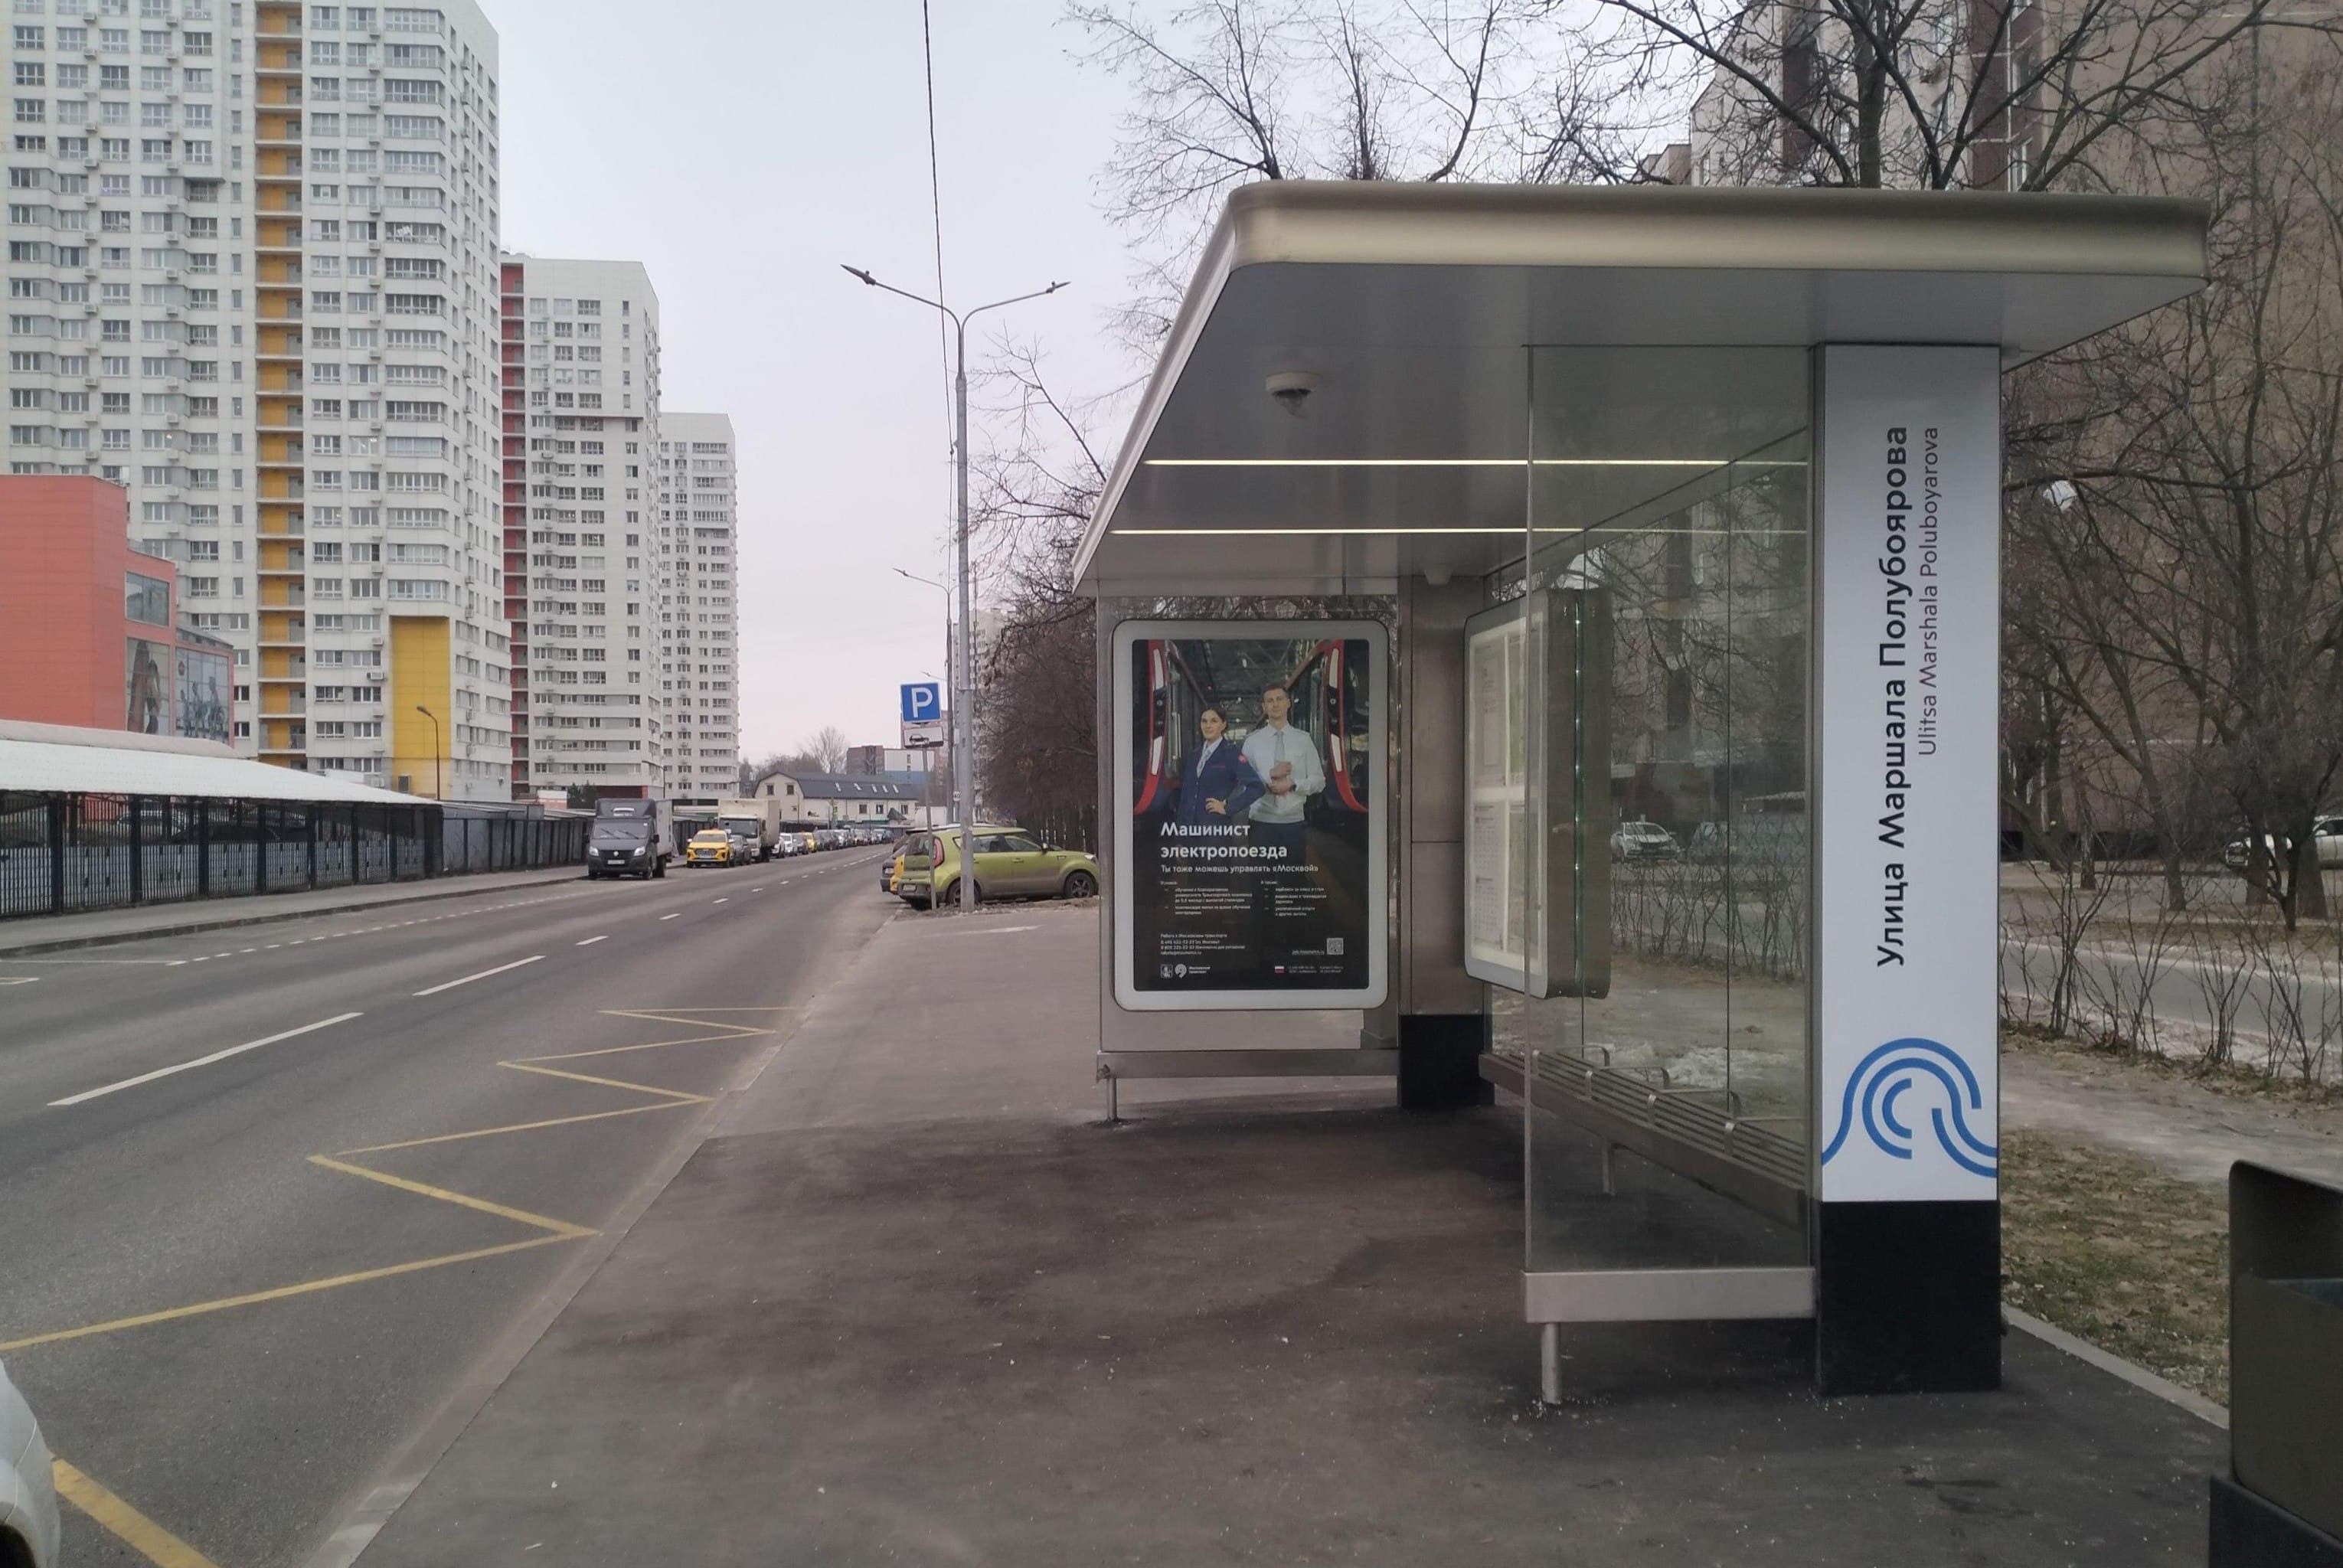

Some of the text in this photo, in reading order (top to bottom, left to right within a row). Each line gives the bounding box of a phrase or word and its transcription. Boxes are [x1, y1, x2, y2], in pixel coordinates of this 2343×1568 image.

[1918, 427, 1943, 756] Ulitsa Marshala Poluboyarova
[911, 687, 933, 718] P
[1877, 426, 1913, 967] Улица Маршала Полубоярова
[1160, 822, 1250, 837] Машинист
[1160, 845, 1288, 861] электропоезда
[1161, 864, 1171, 873] Ты
[1230, 866, 1270, 874] управлять
[1273, 864, 1319, 873] «Москвой»
